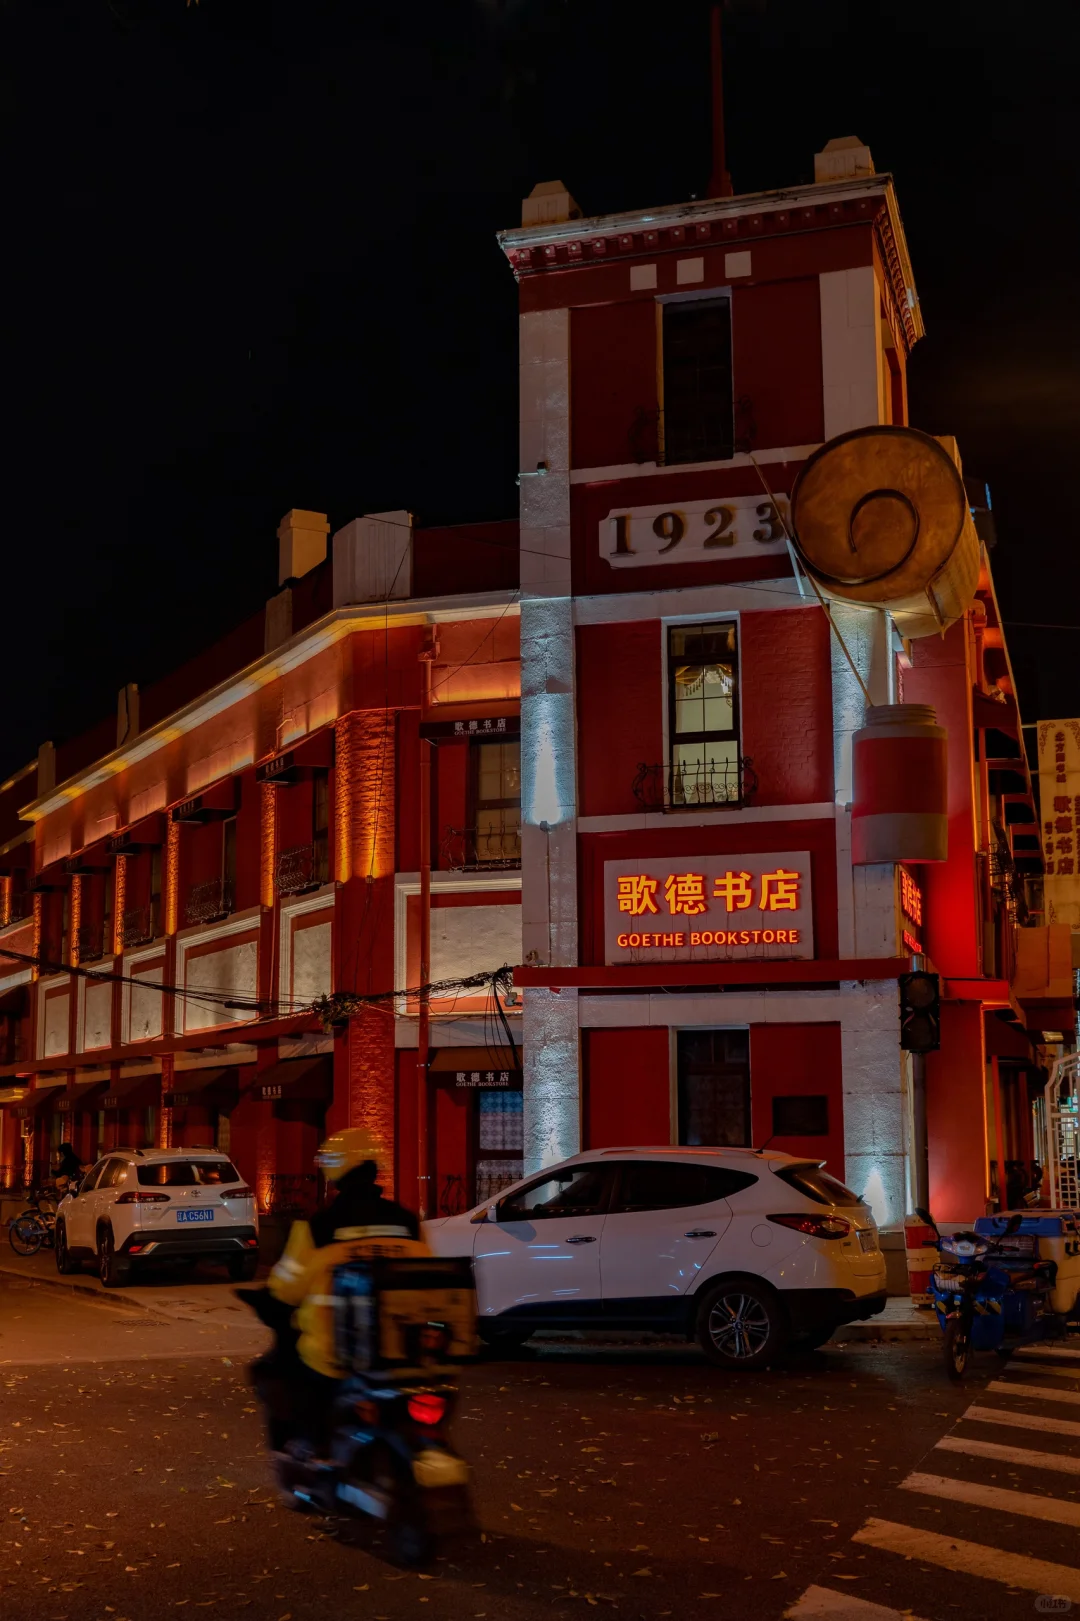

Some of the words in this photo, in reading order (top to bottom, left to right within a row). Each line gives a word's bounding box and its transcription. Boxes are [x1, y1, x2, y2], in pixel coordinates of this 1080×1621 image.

[609, 501, 787, 557] 1923
[617, 868, 799, 916] 歌德书店
[616, 932, 685, 948] GOETHE
[690, 929, 799, 946] BOOKSTORE
[456, 1072, 509, 1082] 歌德书店
